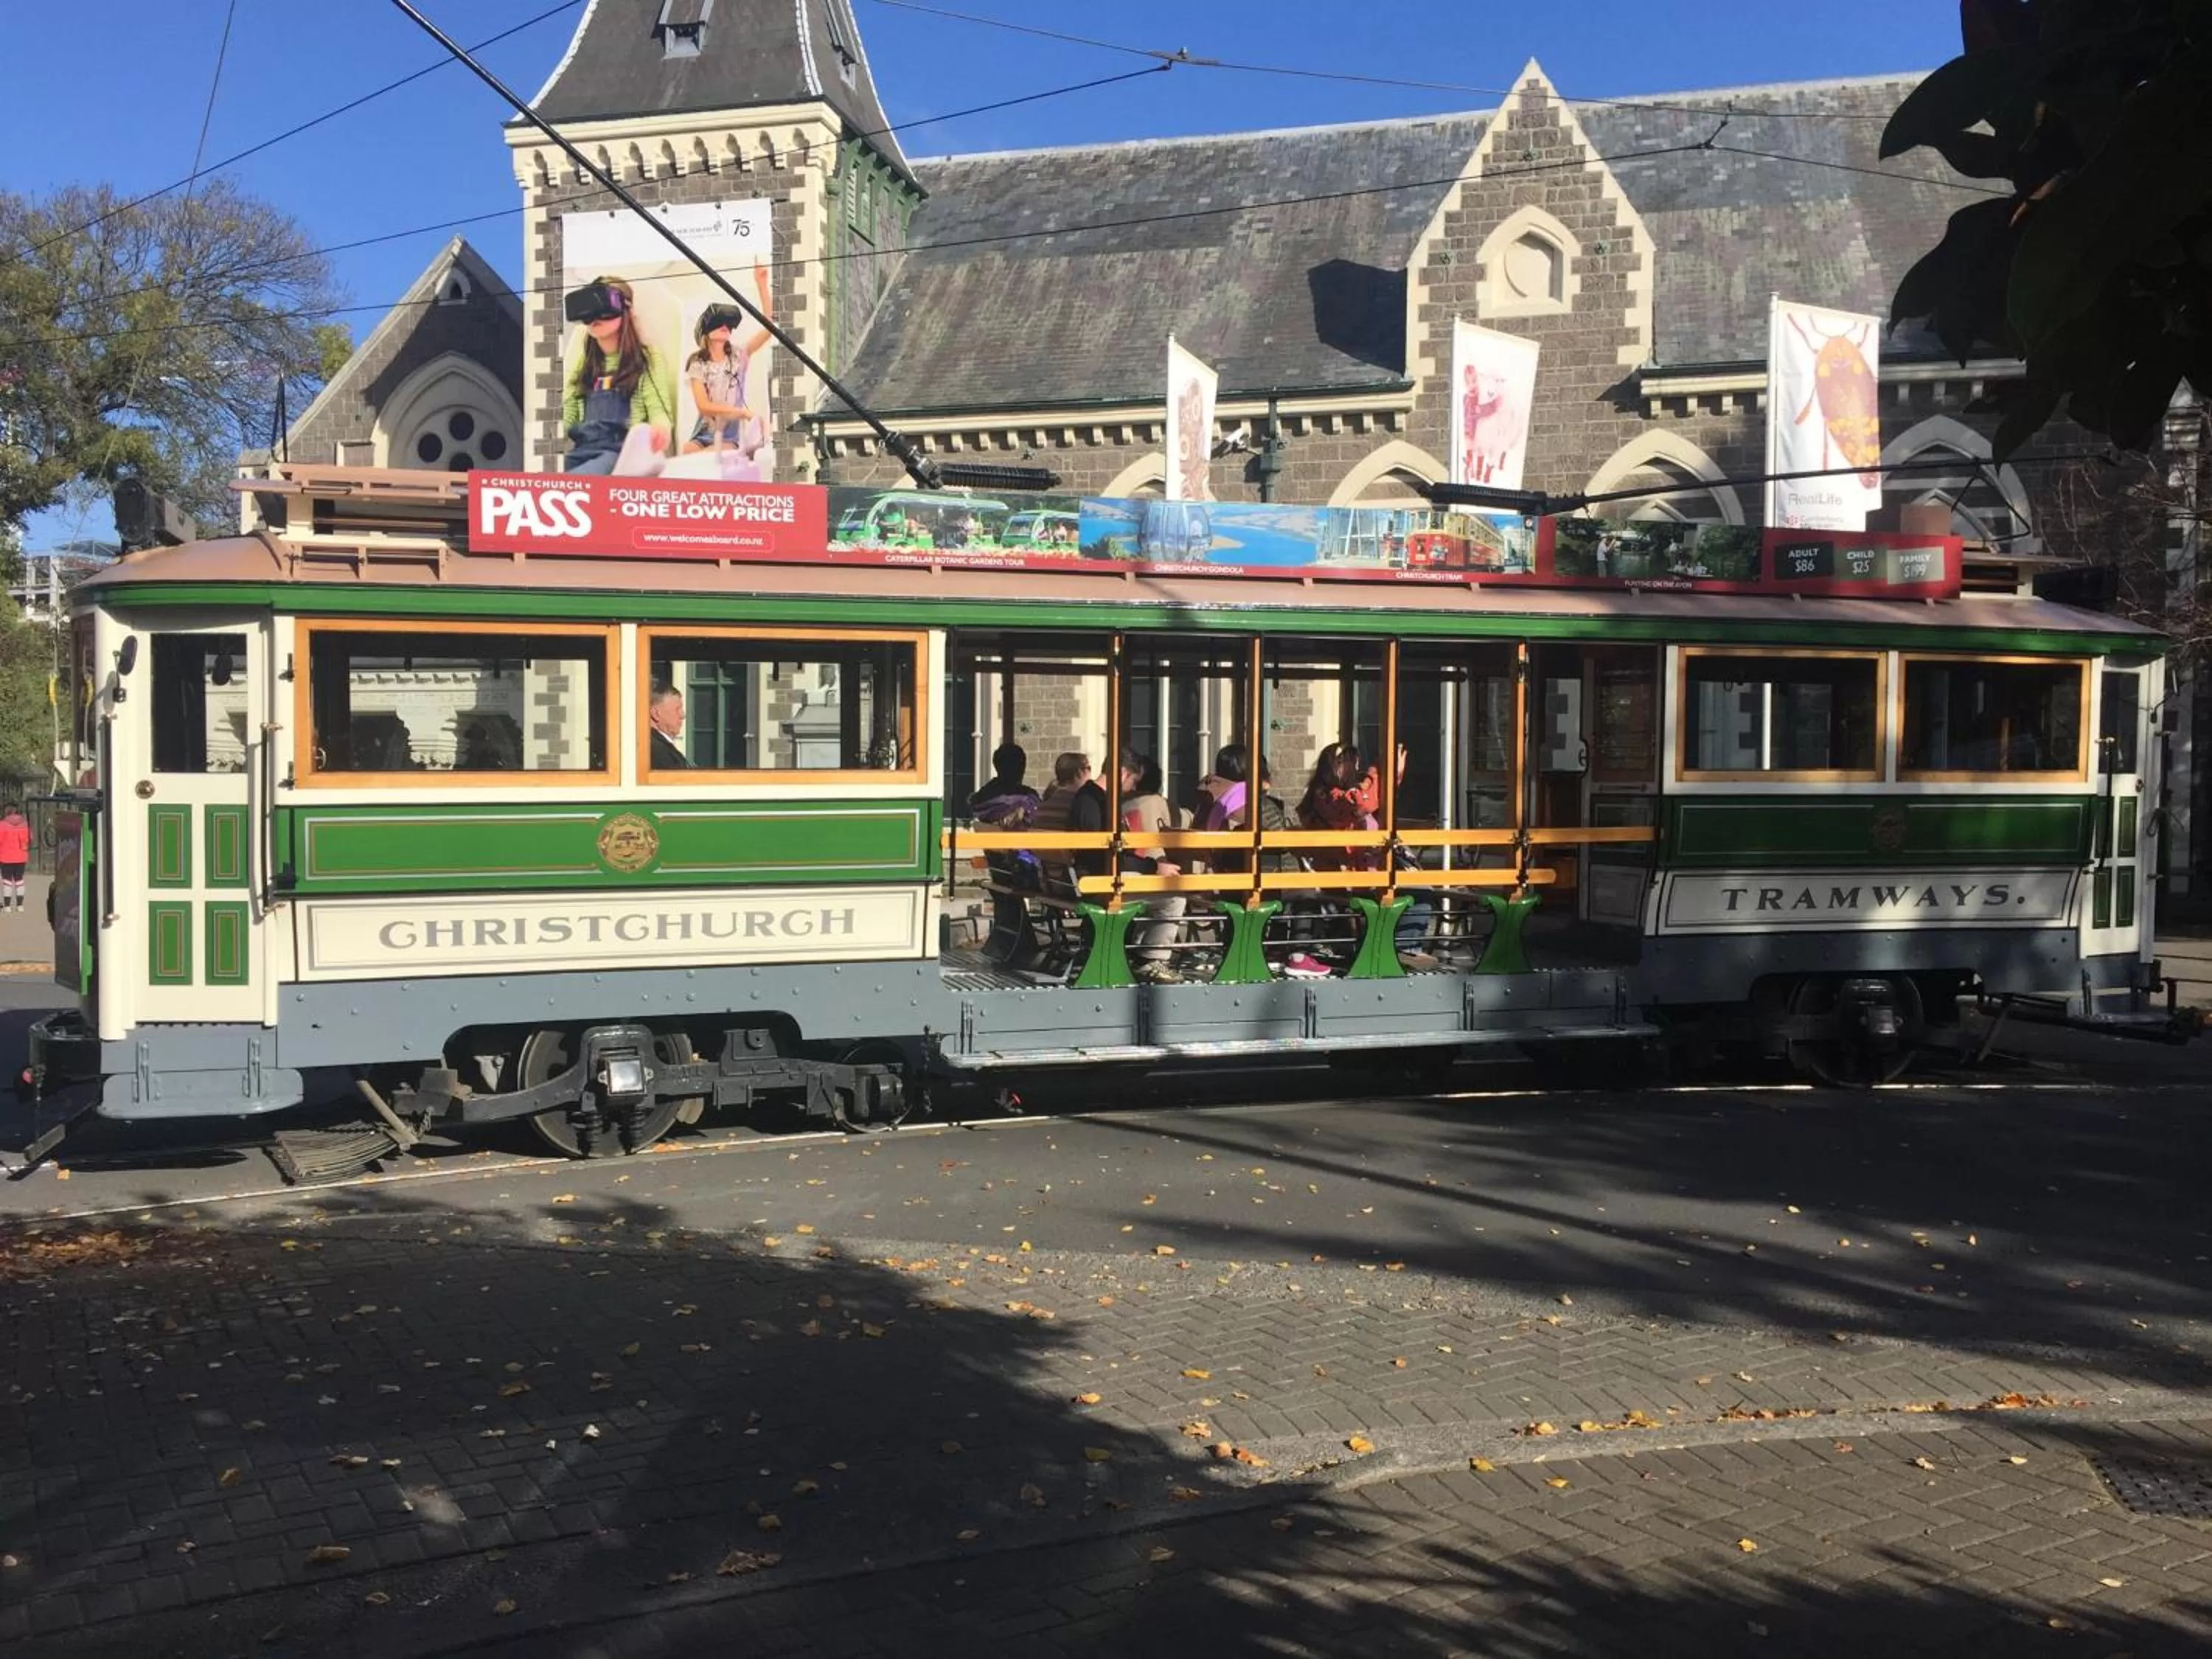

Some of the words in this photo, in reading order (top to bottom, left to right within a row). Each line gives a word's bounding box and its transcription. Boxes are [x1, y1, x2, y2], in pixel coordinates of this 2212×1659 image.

[731, 219, 750, 237] 75
[490, 478, 582, 490] CHRISTCHURCH
[609, 488, 648, 502] FOUR
[651, 490, 696, 504] GREAT
[700, 492, 795, 507] ATTRACTIONS
[481, 487, 592, 538] PASS
[622, 502, 669, 518] ONE
[675, 504, 727, 520] LOW
[733, 506, 795, 522] PRICE
[885, 554, 933, 564] CATERPILLAR
[934, 556, 967, 565] BOTANIC
[969, 557, 1004, 566] GARDENS
[1004, 558, 1026, 567] TOUR
[1788, 548, 1820, 559] ADULT
[1846, 550, 1875, 560] CHILD
[1899, 554, 1932, 563] FAMILY
[1795, 559, 1815, 573] $86
[1852, 560, 1870, 574] $25
[1721, 883, 2025, 912] TRAMWAYS.
